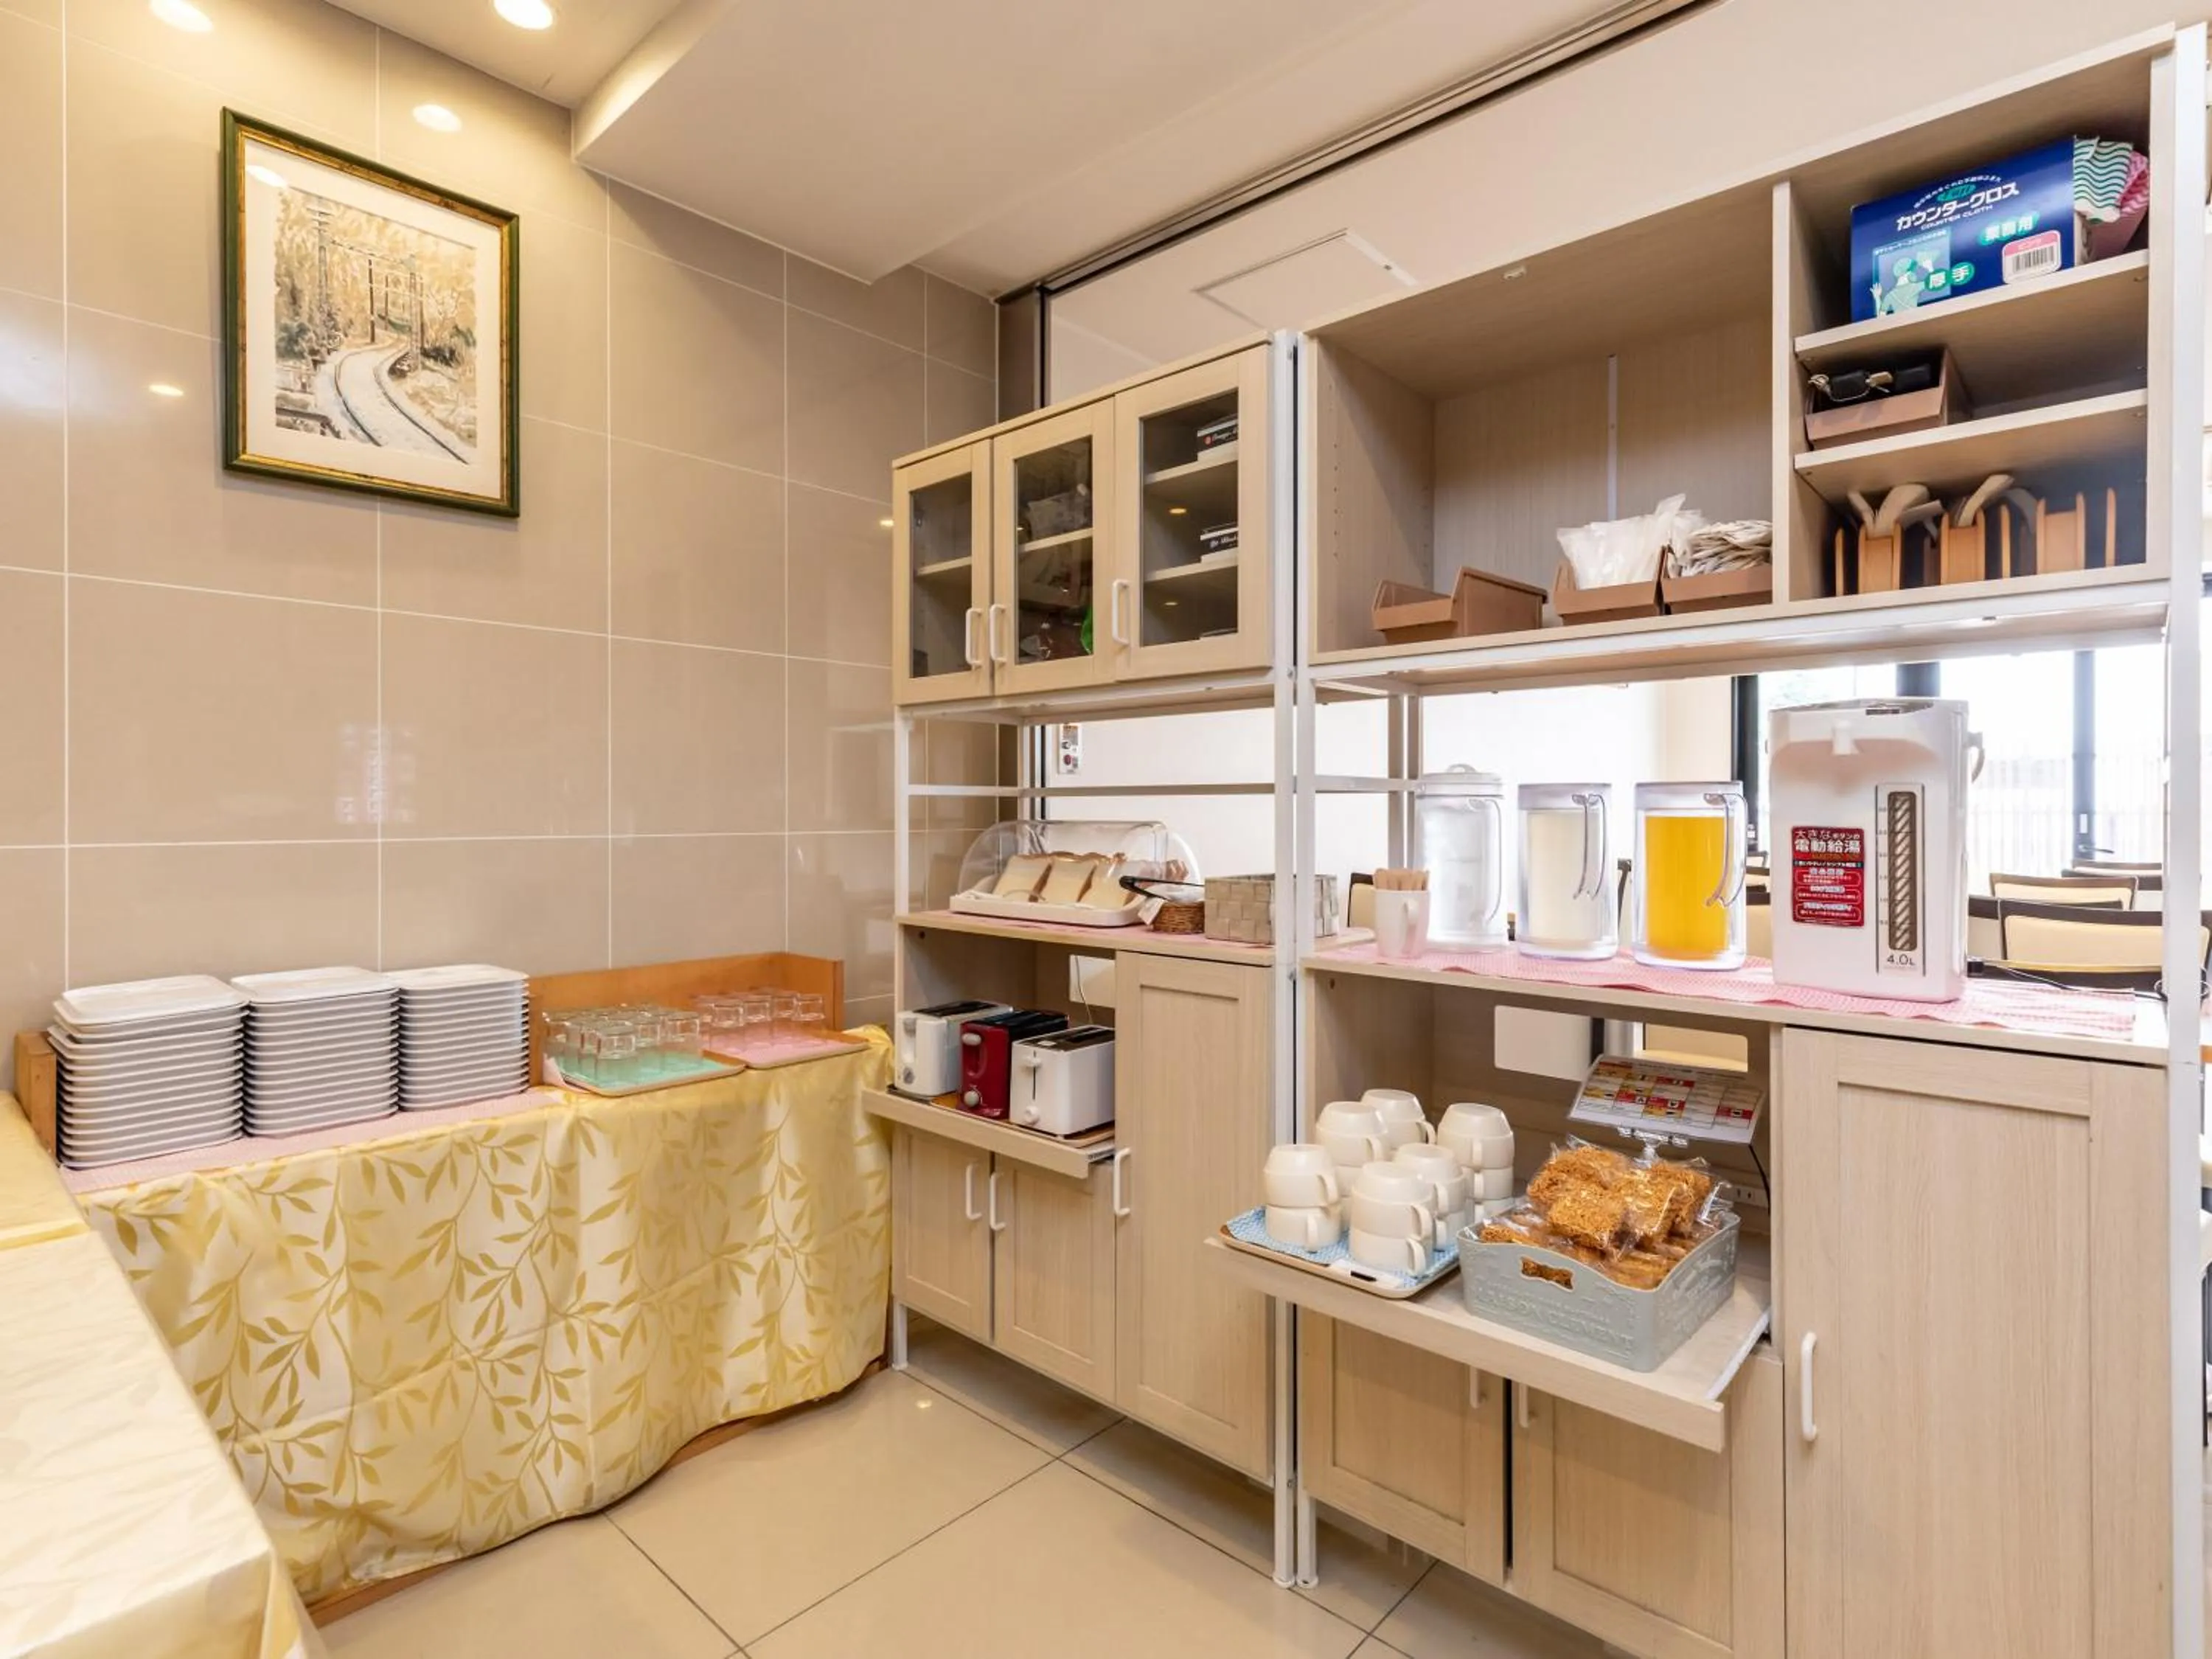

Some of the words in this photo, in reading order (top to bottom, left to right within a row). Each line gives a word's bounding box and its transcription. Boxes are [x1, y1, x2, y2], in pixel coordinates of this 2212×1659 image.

[1896, 181, 2020, 231] カウンタークロス
[1794, 838, 1861, 853] 電動給湯
[1887, 953, 1916, 966] 4.0L
